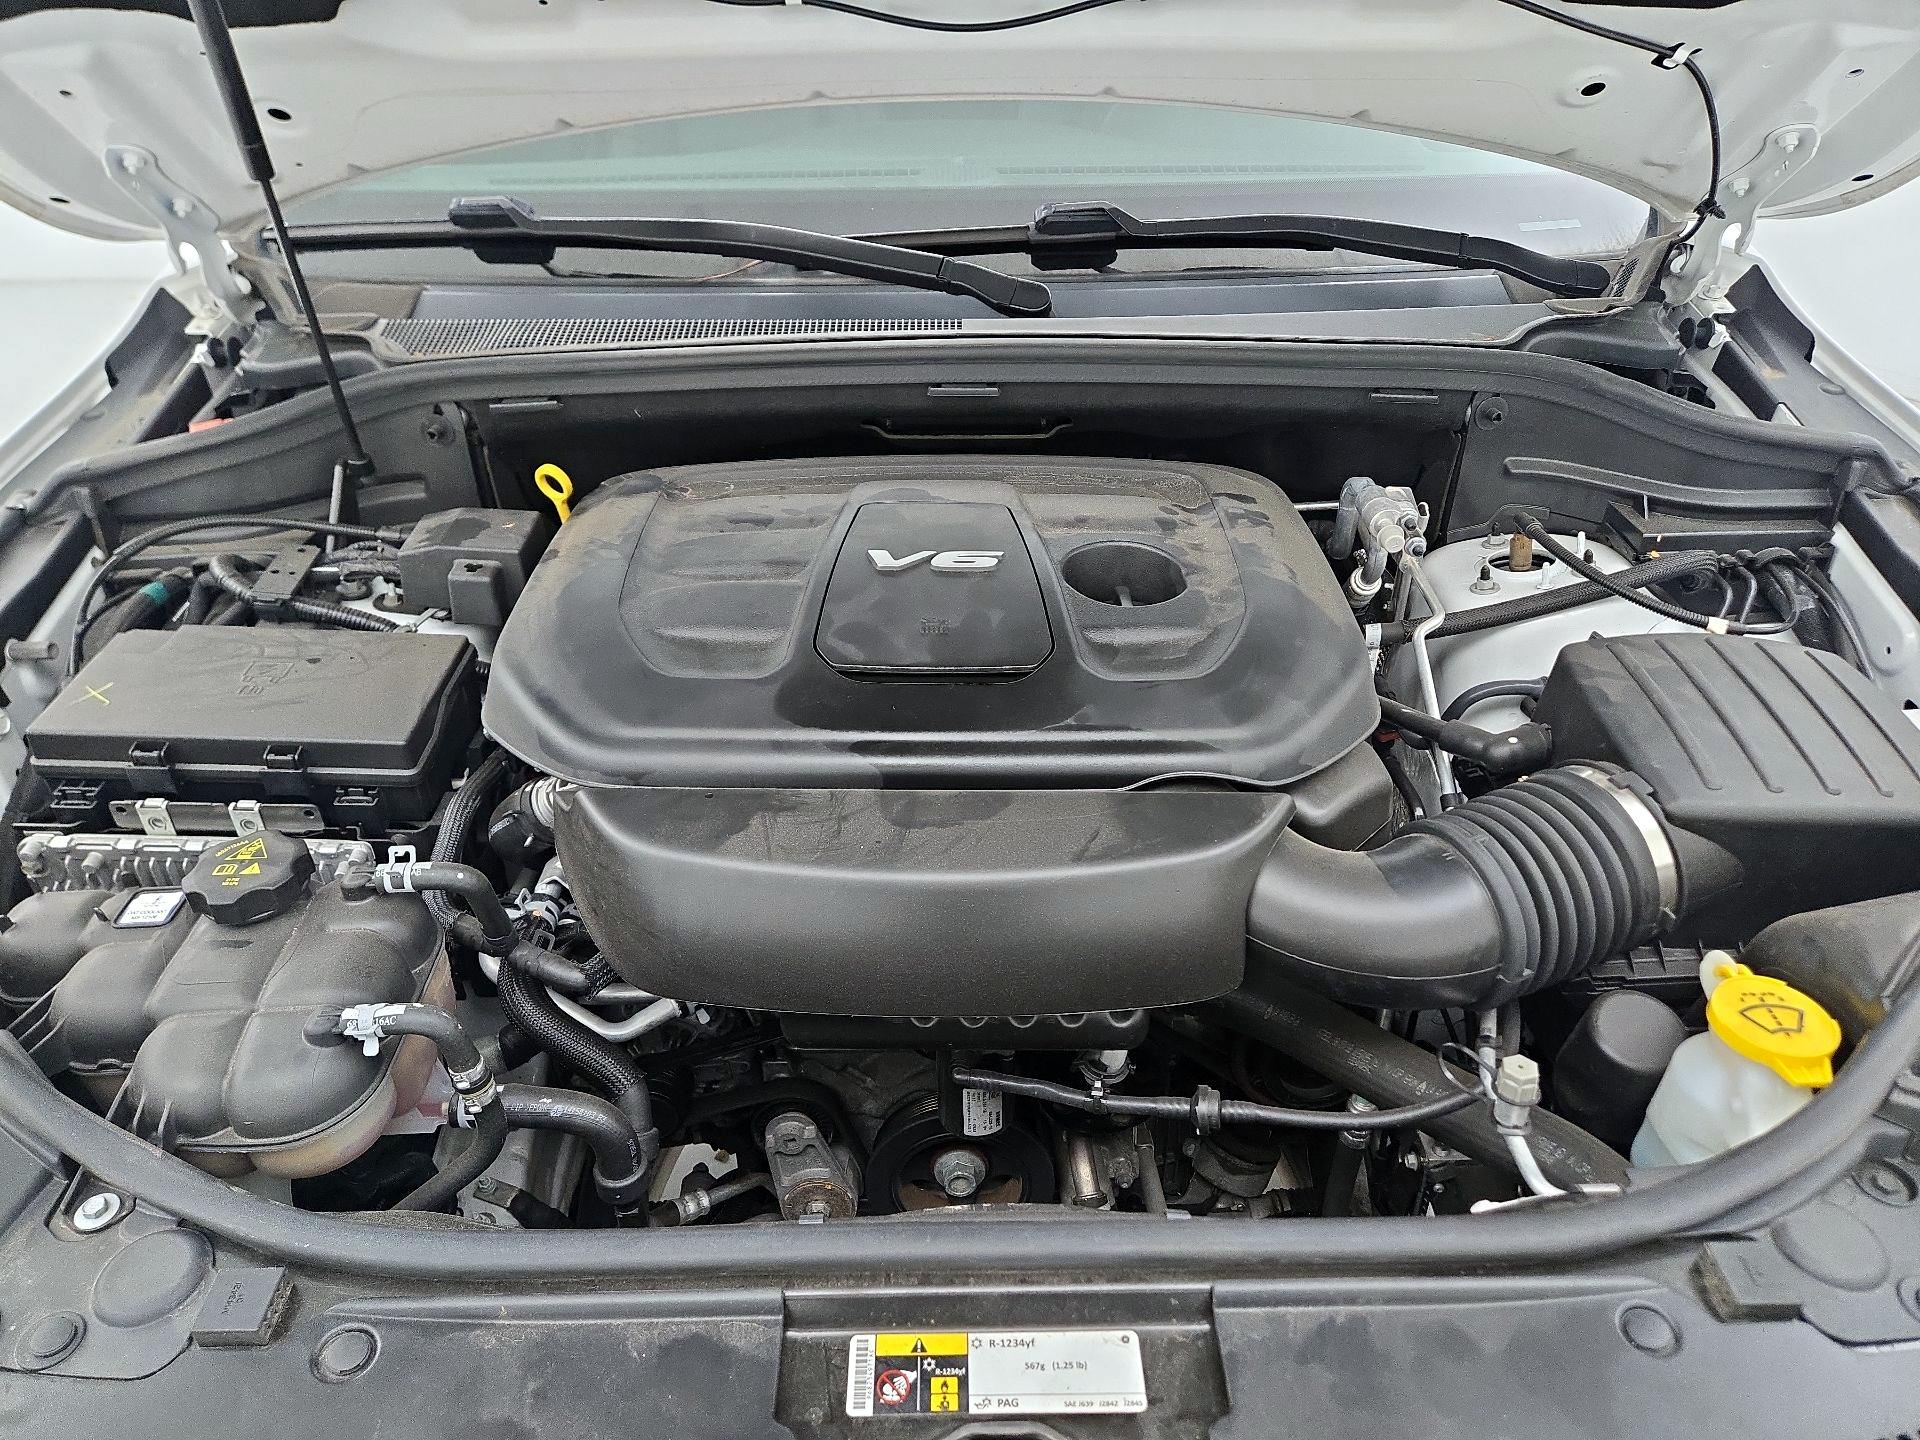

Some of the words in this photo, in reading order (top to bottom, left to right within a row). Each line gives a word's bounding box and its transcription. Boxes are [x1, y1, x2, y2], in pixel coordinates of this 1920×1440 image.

[867, 549, 1004, 571] V6
[989, 1338, 1035, 1349] R-1234yf
[1024, 1361, 1046, 1371] 567g
[1052, 1361, 1074, 1370] (1.25
[1075, 1361, 1088, 1370] lb)
[997, 1398, 1019, 1407] PAG
